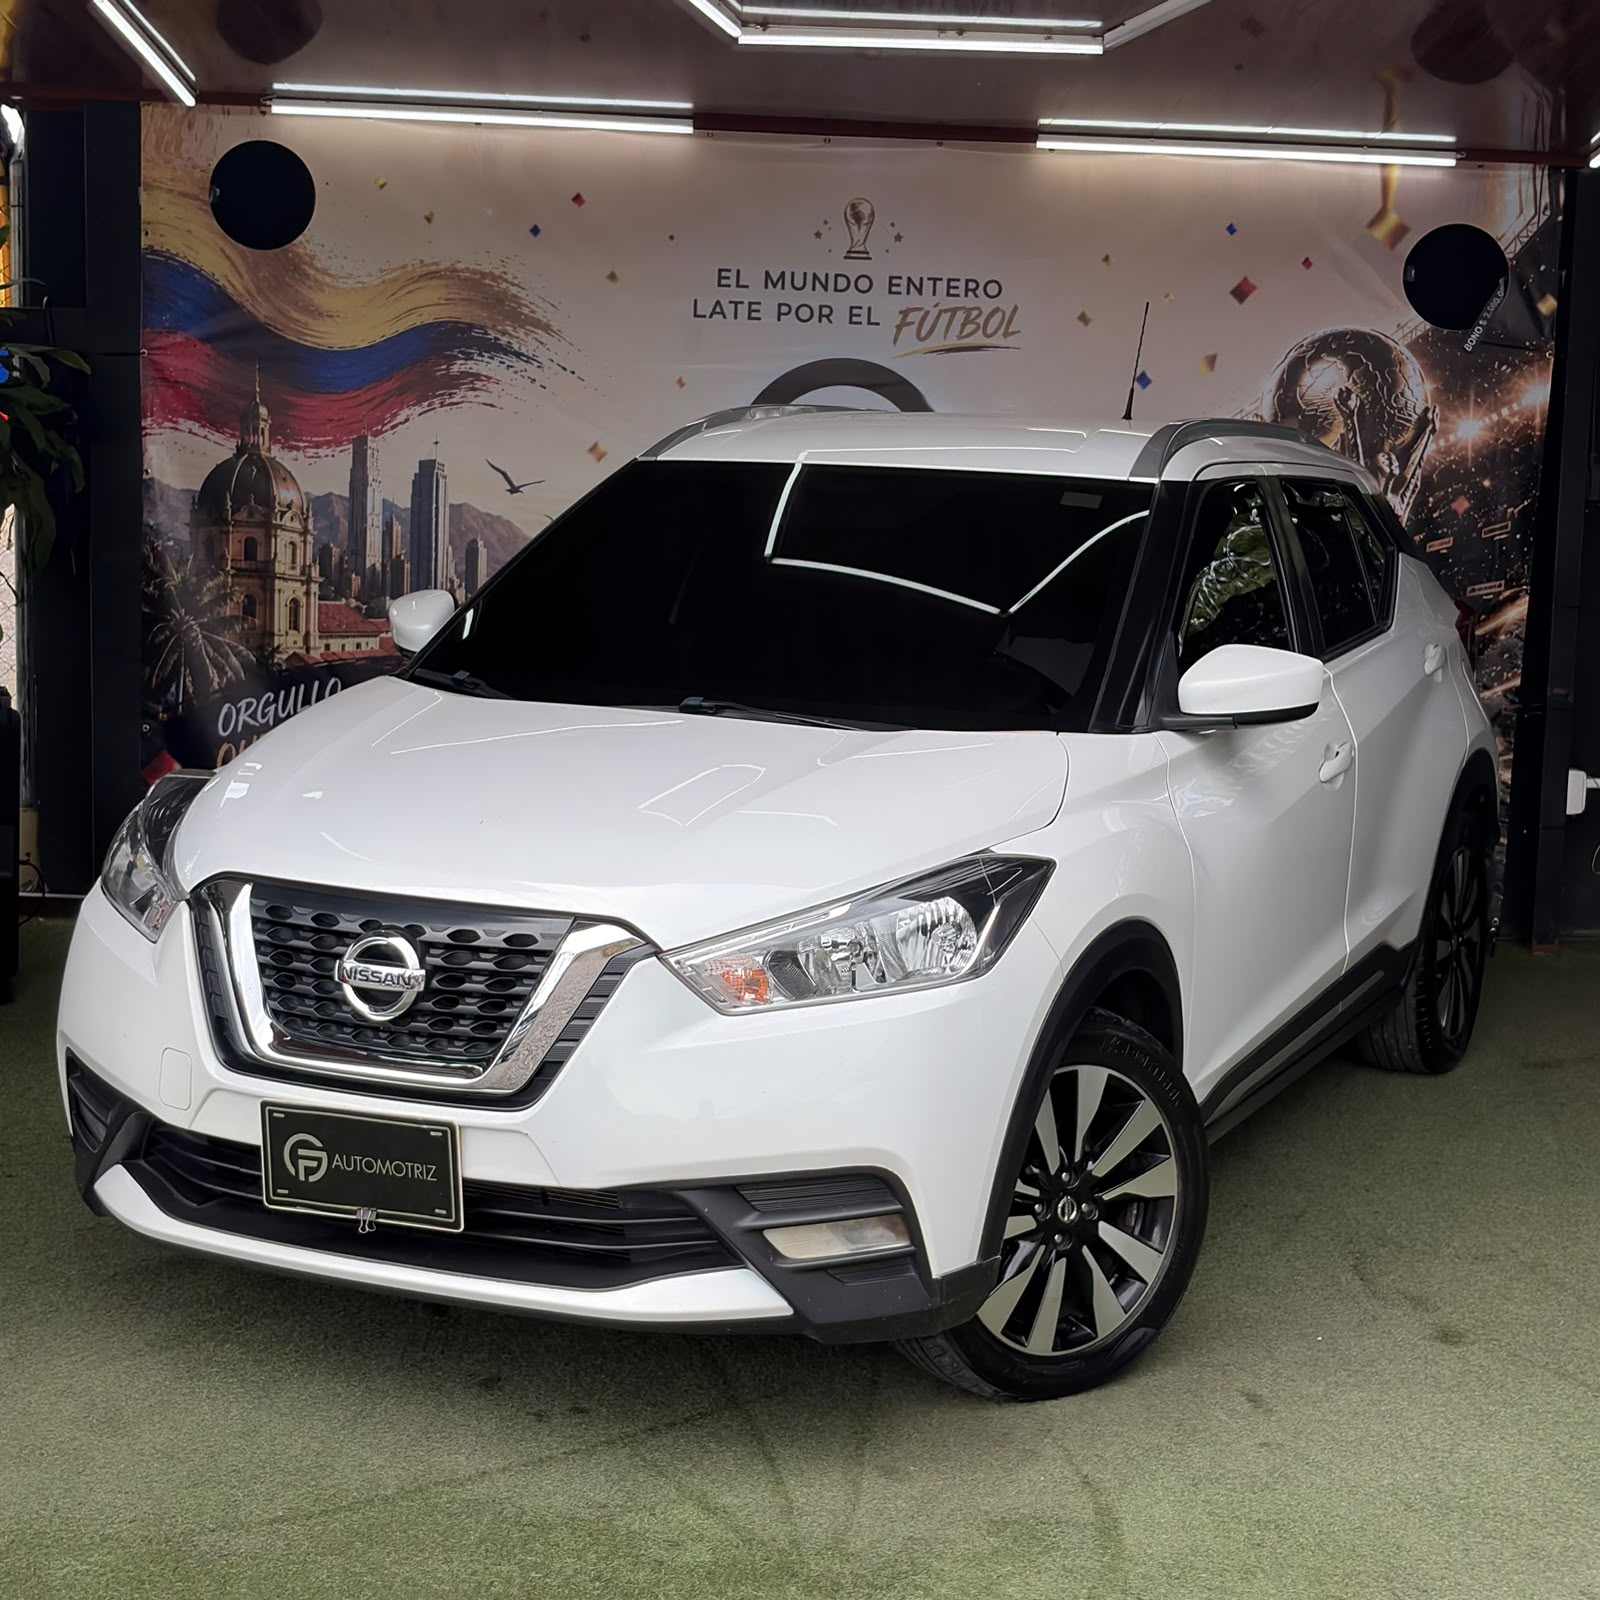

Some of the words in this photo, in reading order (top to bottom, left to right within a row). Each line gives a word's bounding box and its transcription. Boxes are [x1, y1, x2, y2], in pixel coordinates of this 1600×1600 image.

[716, 268, 750, 289] EL
[763, 270, 874, 294] MUNDO
[887, 275, 1003, 299] ENTERO
[692, 298, 763, 321] LATE
[776, 302, 834, 324] POR
[848, 305, 881, 326] EL
[892, 302, 1022, 348] FÚTBOL
[1463, 326, 1483, 352] BONO
[341, 966, 412, 987] NISSAN
[331, 1153, 438, 1182] AUTOMOTRIZ
